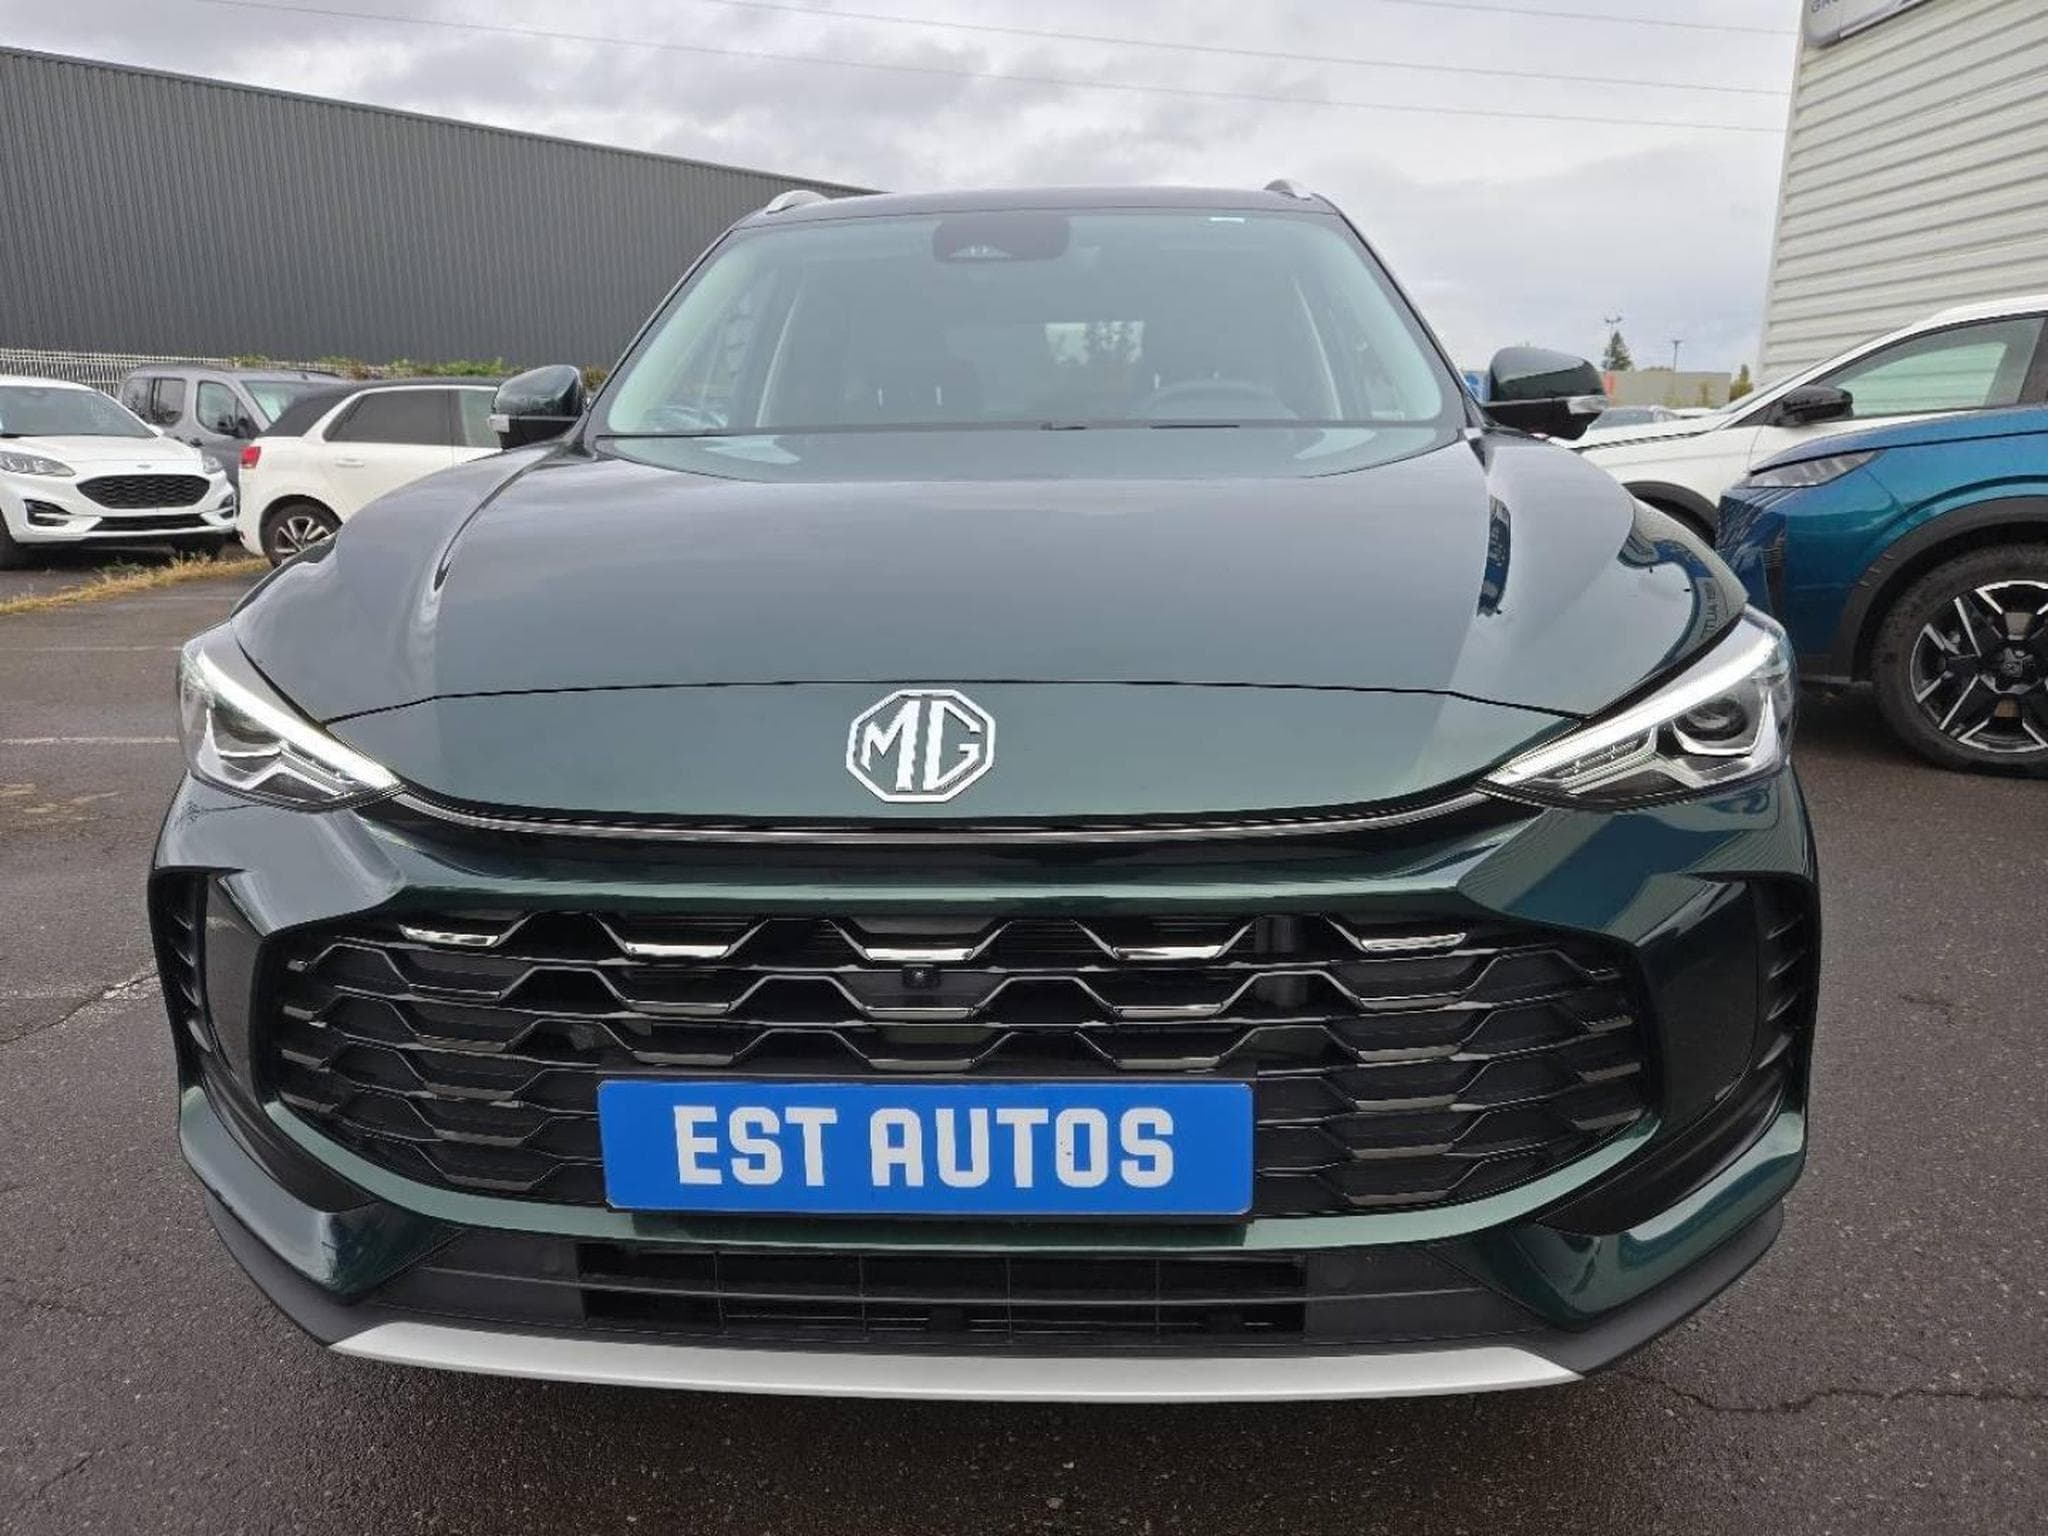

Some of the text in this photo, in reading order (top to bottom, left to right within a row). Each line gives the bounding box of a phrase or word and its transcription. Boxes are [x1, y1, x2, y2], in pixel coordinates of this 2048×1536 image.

[859, 700, 981, 792] MG
[673, 1105, 1176, 1189] EST AUTOS
